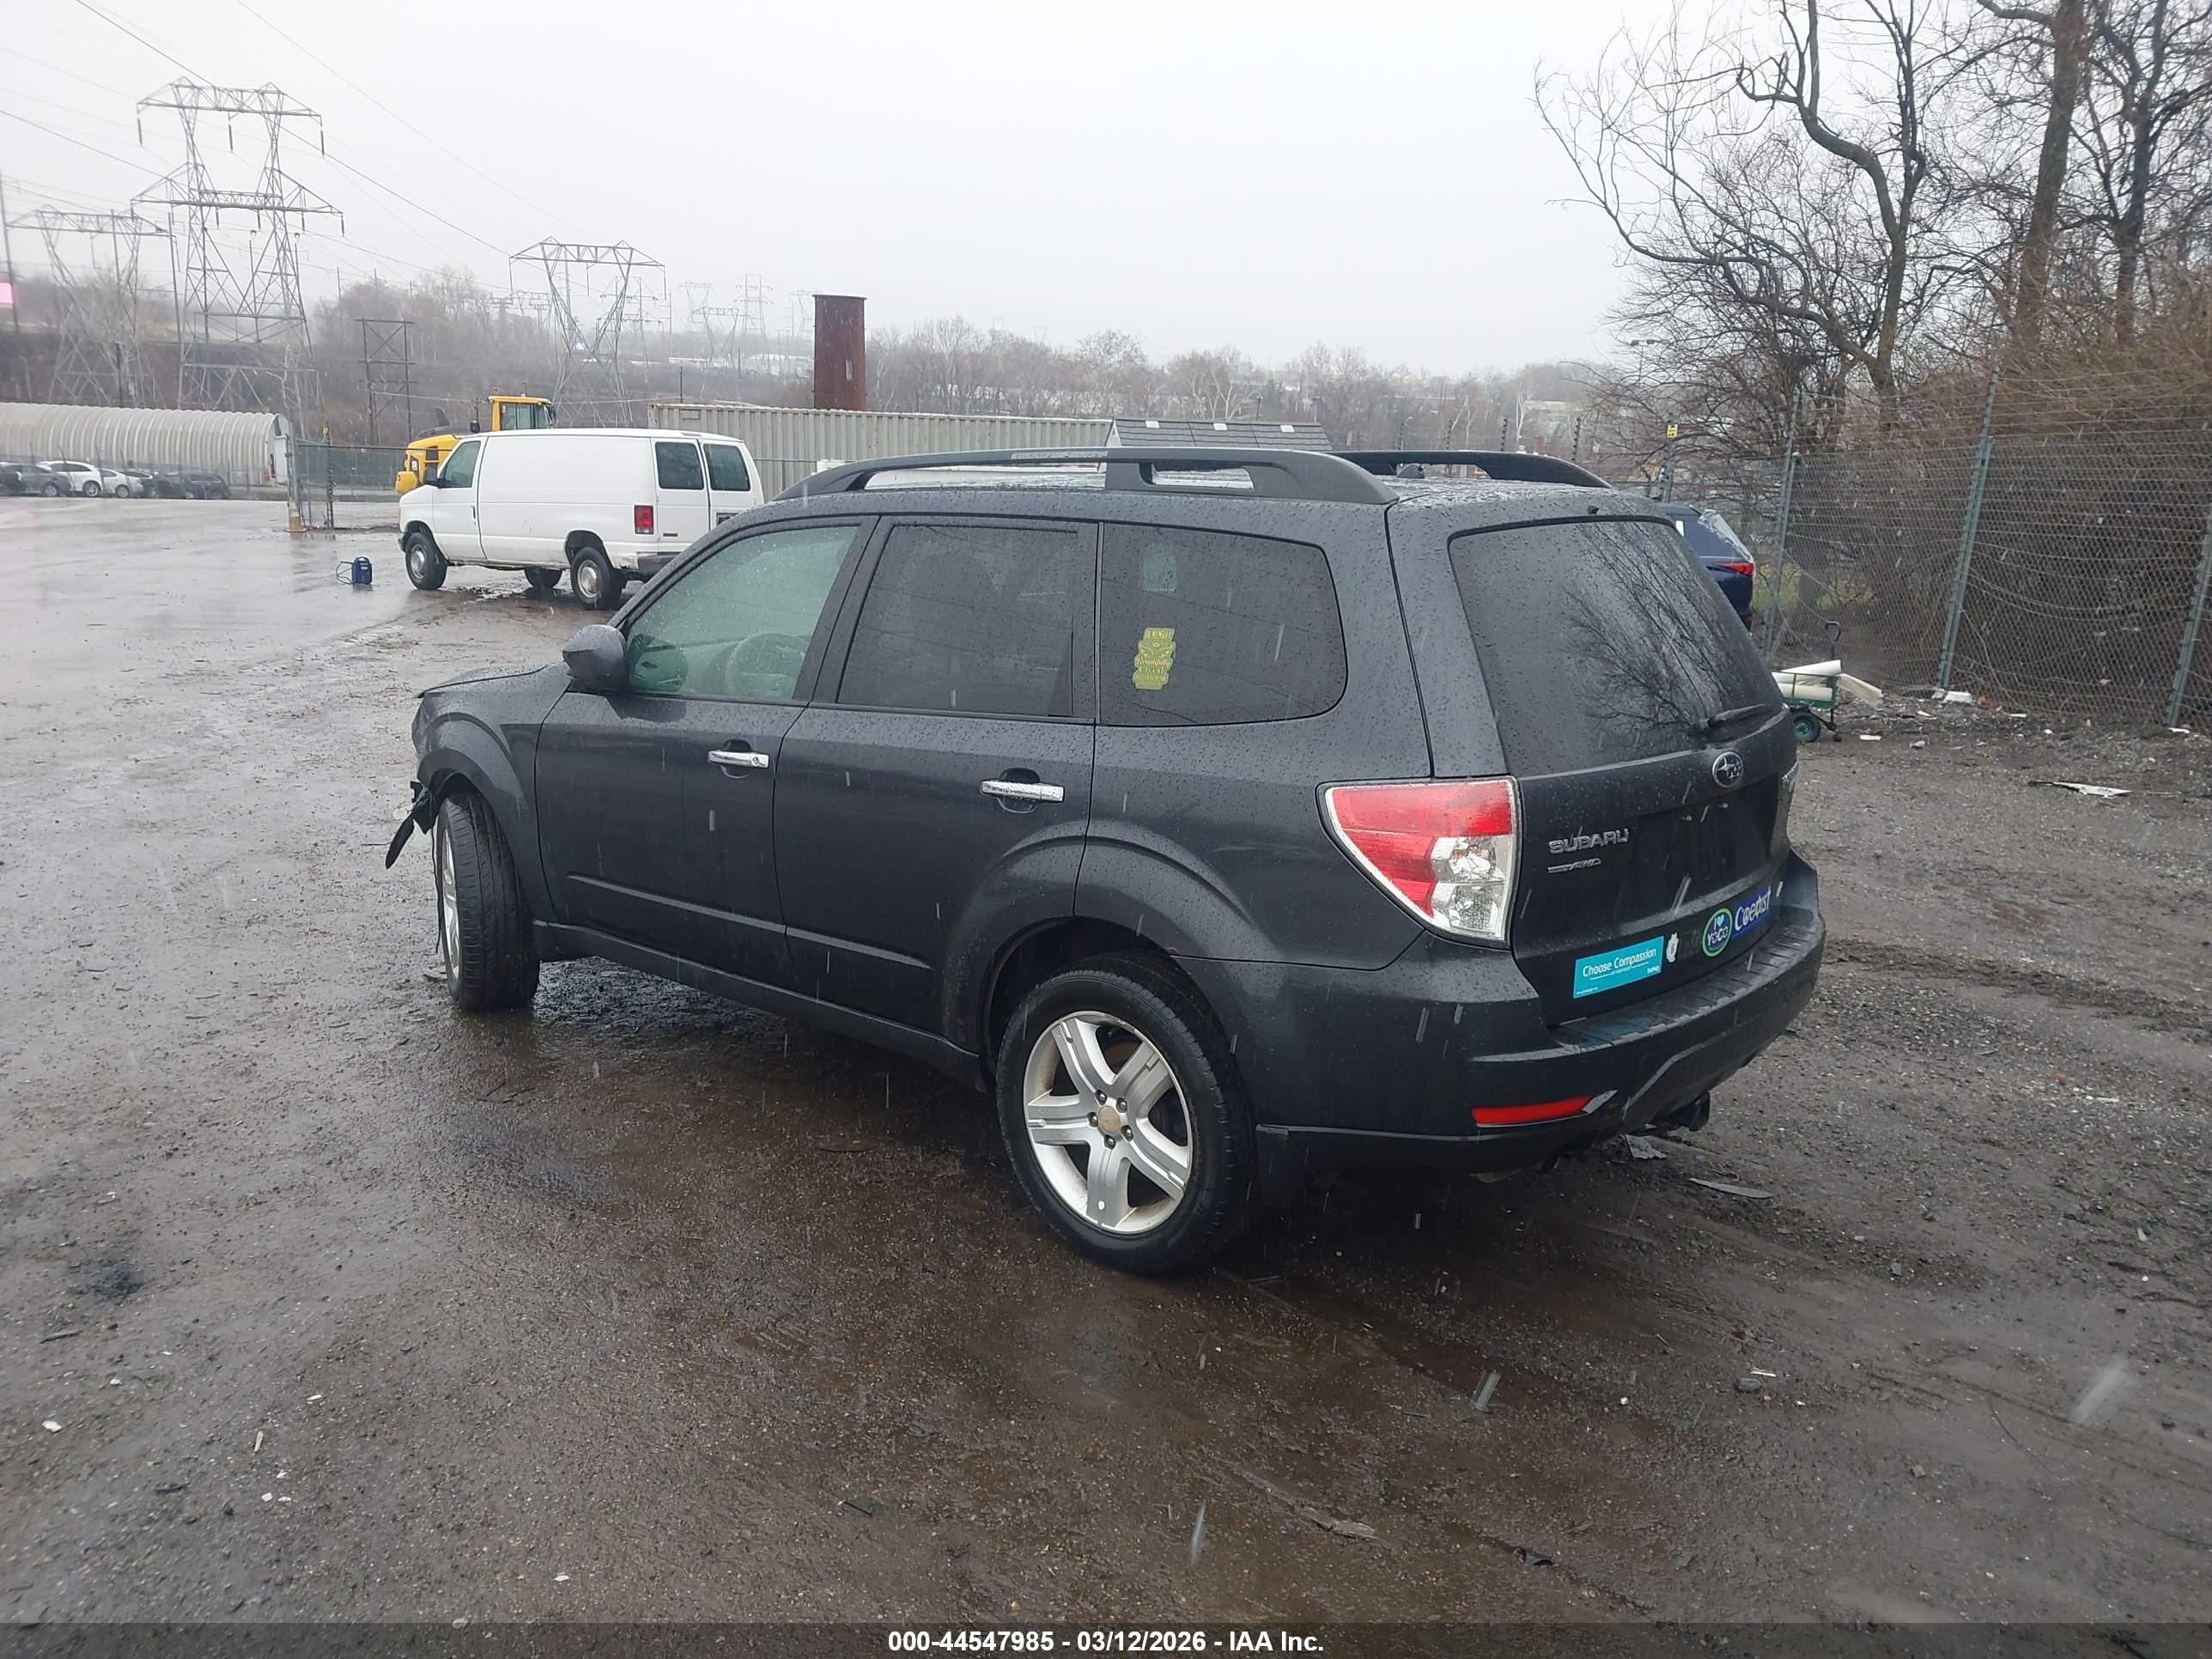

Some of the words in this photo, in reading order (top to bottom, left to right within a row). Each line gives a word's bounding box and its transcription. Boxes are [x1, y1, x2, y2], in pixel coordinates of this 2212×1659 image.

[1548, 828, 1630, 854] SUBARU
[1583, 961, 1613, 977] Choose
[1614, 947, 1657, 969] Compassion
